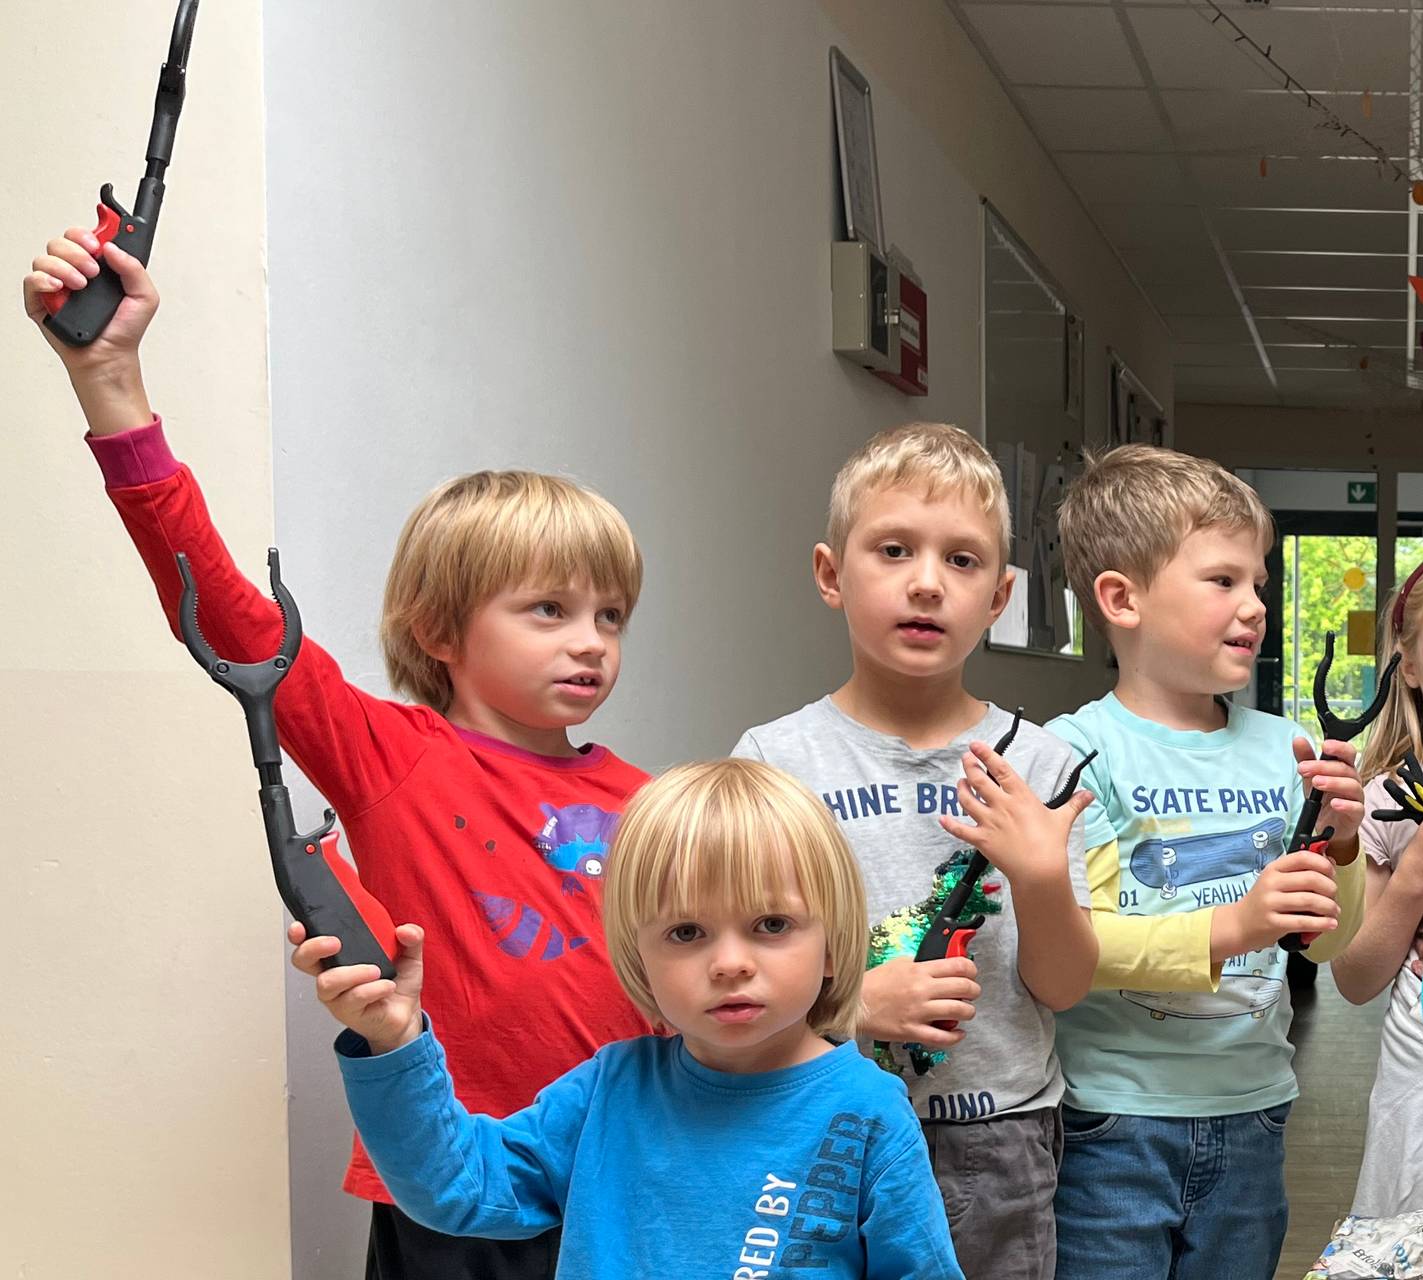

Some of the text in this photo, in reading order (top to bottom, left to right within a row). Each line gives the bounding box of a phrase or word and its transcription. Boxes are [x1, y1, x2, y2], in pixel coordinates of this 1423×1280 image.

[823, 782, 969, 821] HINE BR
[1132, 785, 1289, 815] SKATE PARK
[928, 1091, 996, 1120] DINO
[754, 1173, 797, 1217] BY
